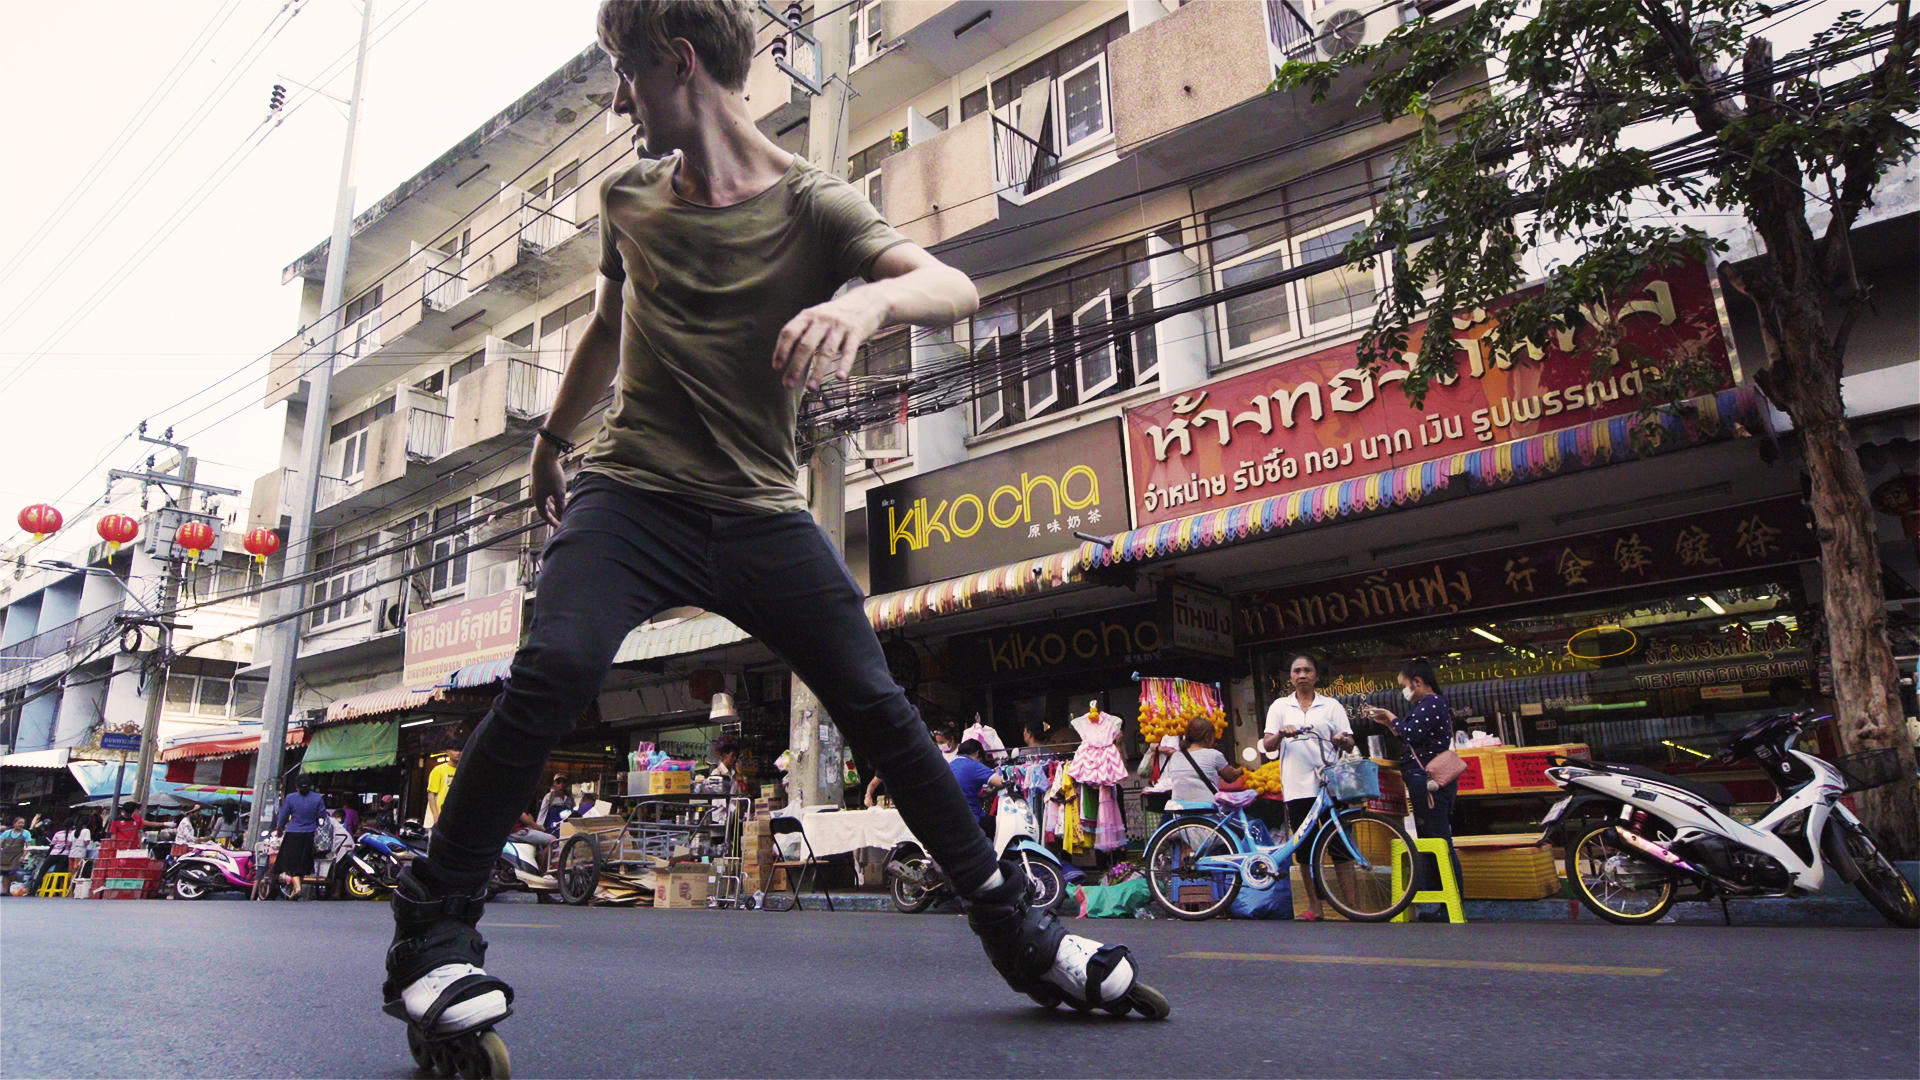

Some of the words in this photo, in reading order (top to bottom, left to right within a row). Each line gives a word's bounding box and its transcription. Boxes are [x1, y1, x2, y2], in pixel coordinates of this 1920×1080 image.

[1144, 473, 1227, 512] จำหน่าย
[1233, 447, 1298, 491] รับซื้อ
[1305, 442, 1354, 474] ทอง
[1361, 428, 1413, 461] นาก
[1420, 415, 1464, 448] เงิน
[1028, 509, 1102, 538] 原味奶茶
[410, 588, 520, 655] ทองบริสุทธิ์
[1634, 672, 1672, 691] TIEN
[1673, 667, 1716, 687] FUNG
[1717, 659, 1810, 684] GOLDSMITH
